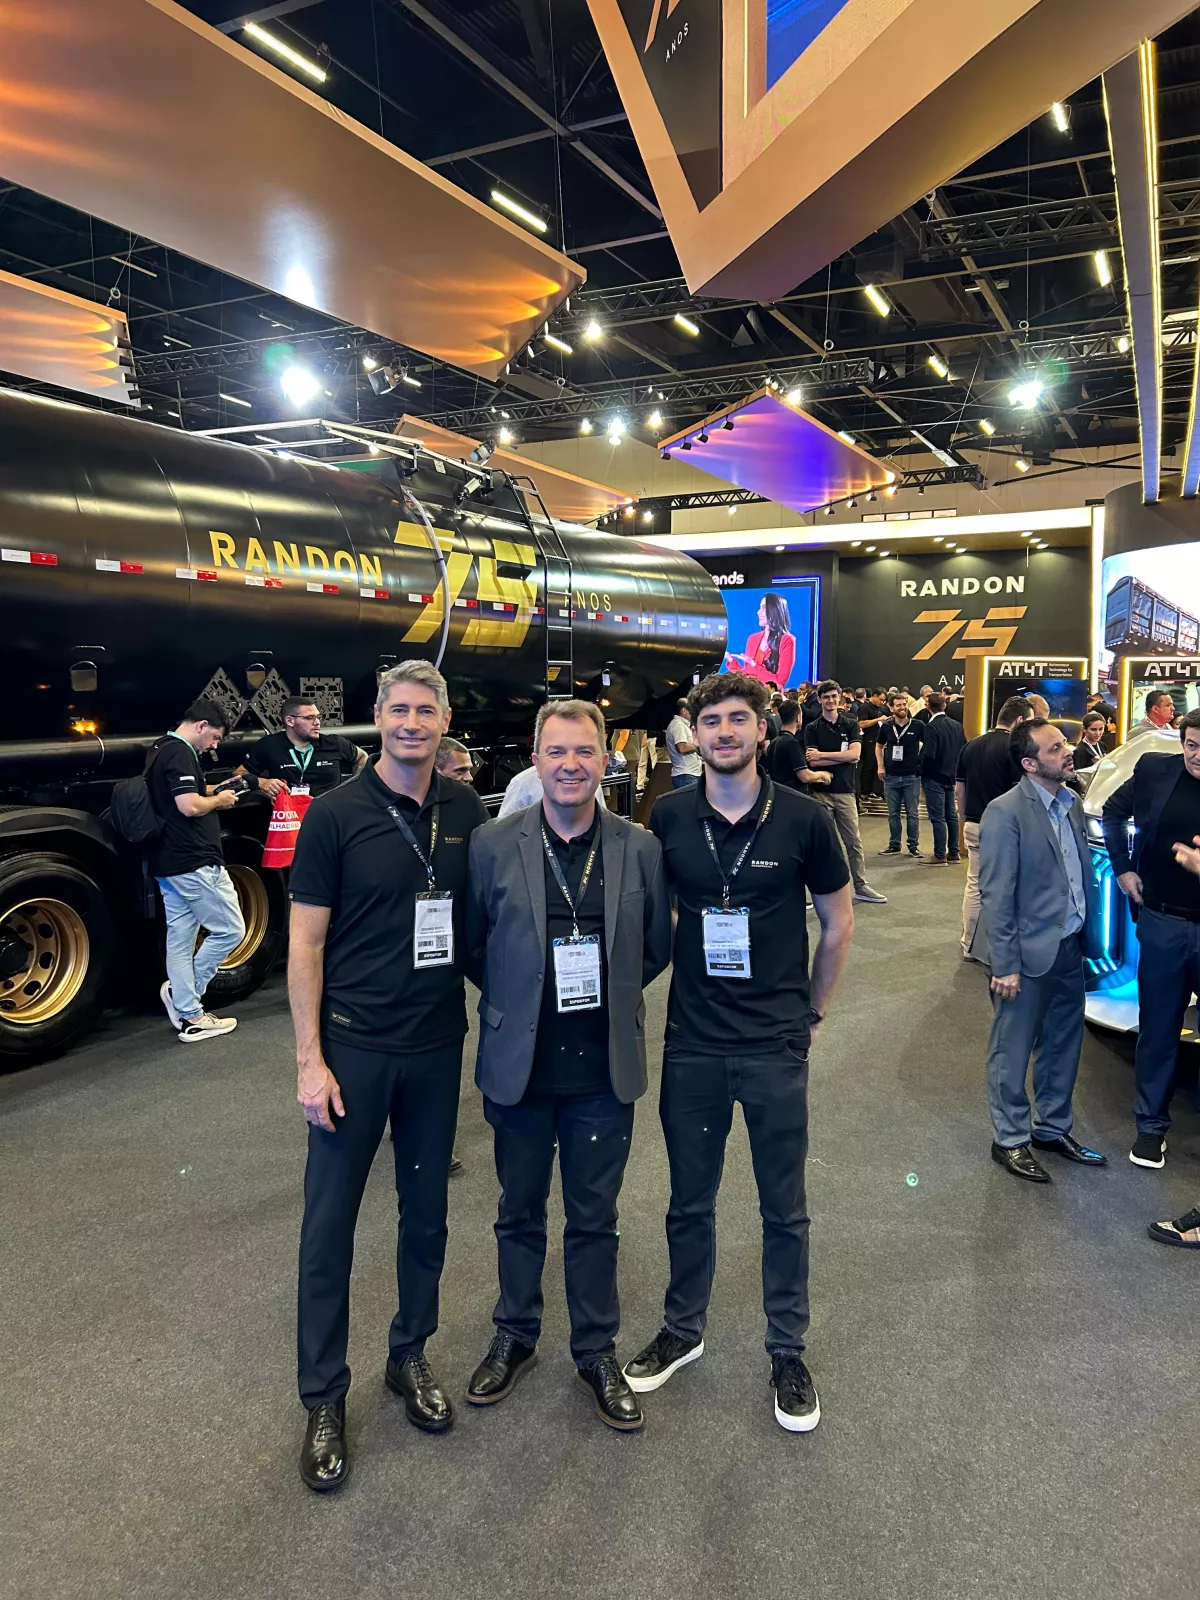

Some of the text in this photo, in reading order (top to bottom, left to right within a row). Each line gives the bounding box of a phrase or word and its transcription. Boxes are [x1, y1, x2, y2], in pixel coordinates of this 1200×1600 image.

[665, 22, 689, 63] ANOS
[209, 521, 537, 647] RANDON 75
[710, 571, 745, 586] ands
[900, 575, 1025, 597] RANDON
[911, 605, 1028, 660] 75
[938, 674, 965, 685] AN
[998, 661, 1048, 677] AT4T
